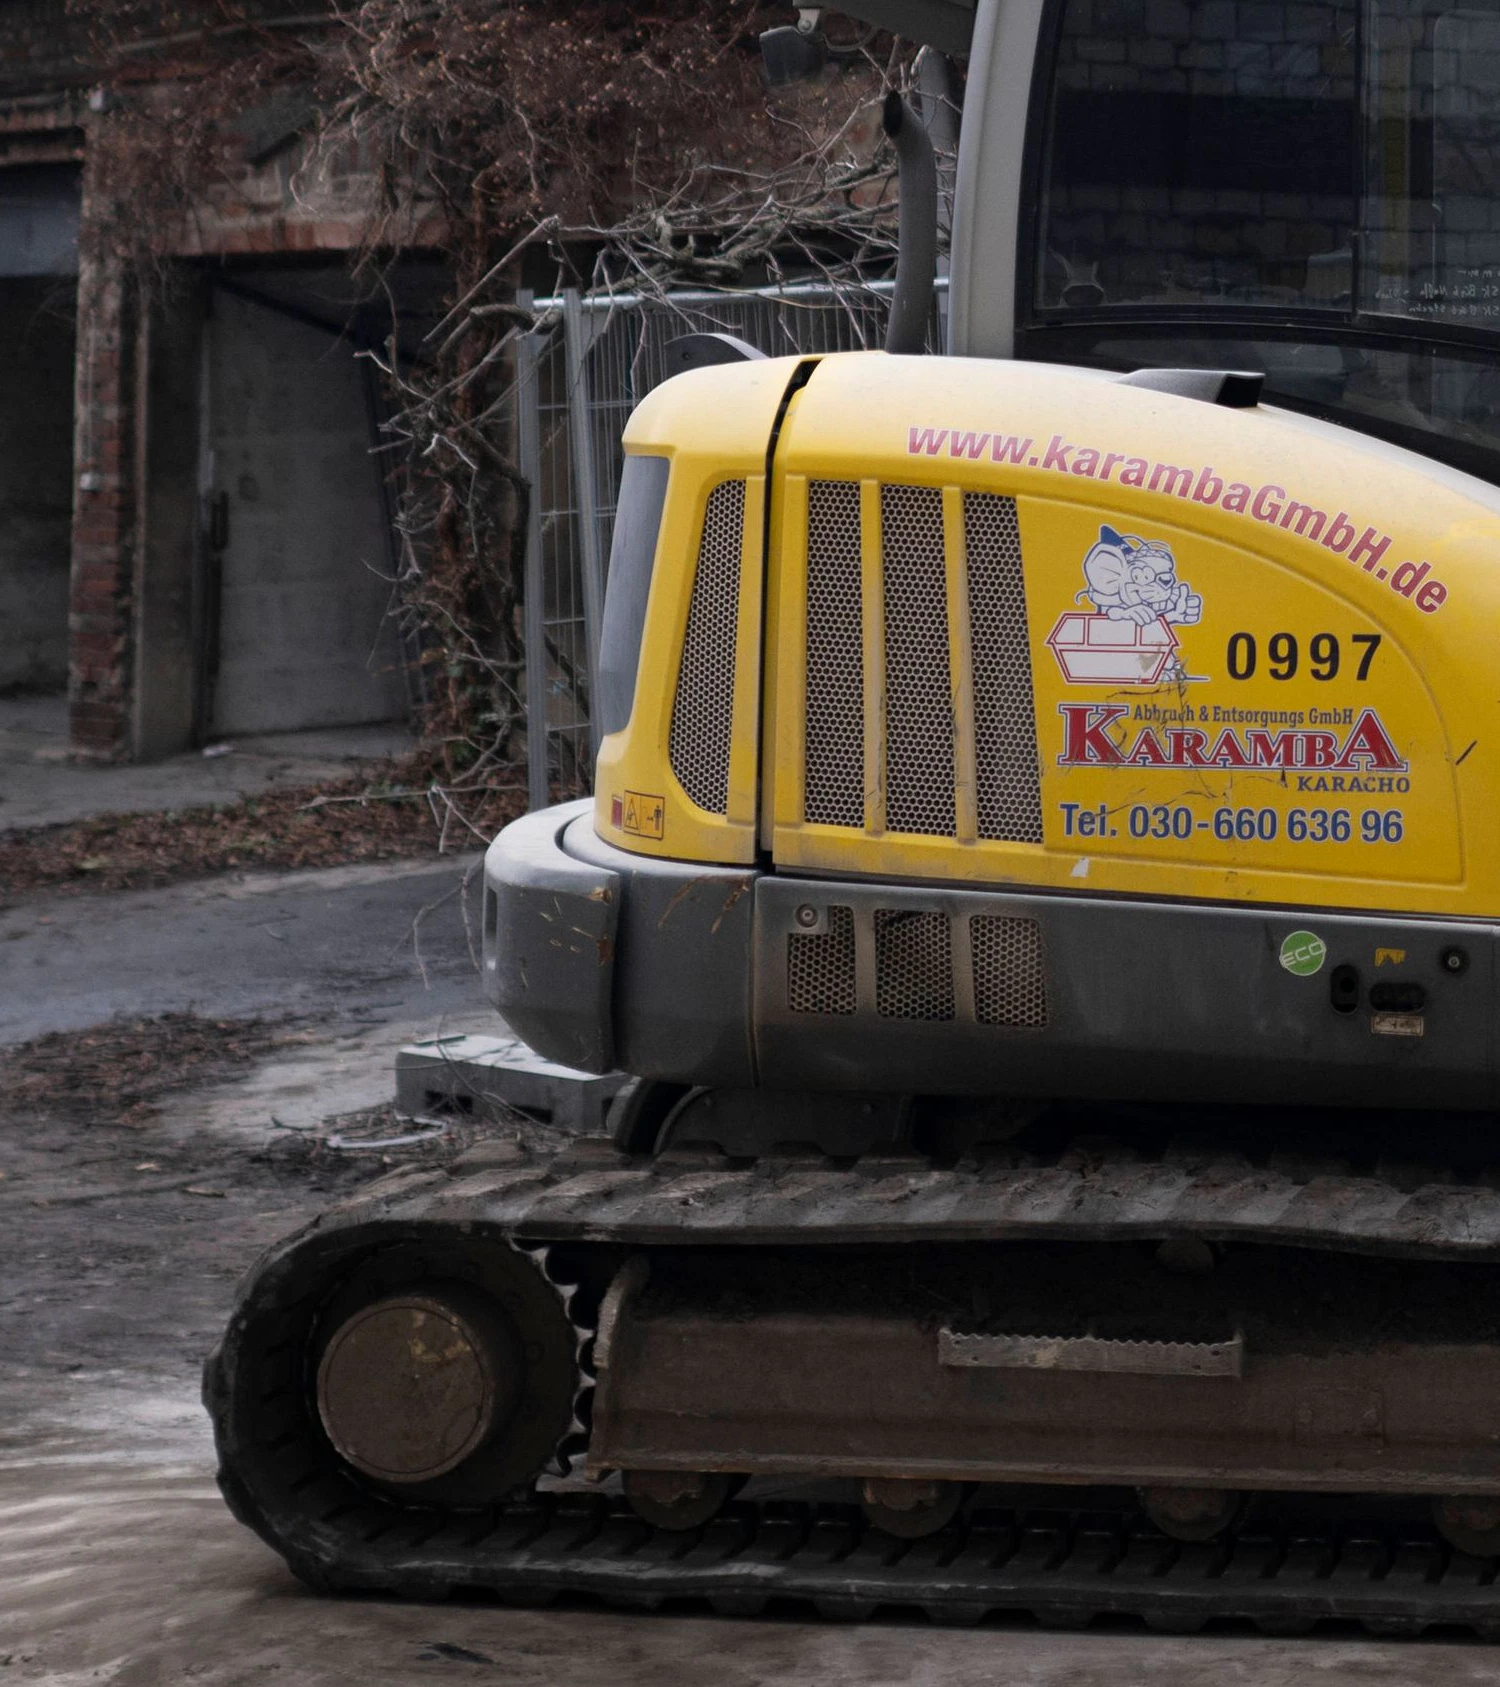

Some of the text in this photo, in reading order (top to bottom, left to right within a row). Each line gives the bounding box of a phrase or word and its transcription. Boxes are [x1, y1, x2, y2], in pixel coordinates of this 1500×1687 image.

[906, 425, 1449, 614] www.karambaGmbH.de
[1226, 632, 1382, 681] 0997
[1133, 705, 1353, 728] Abbruch & Entsorgungs GmbH
[1056, 703, 1409, 773] KARAMBA
[1297, 776, 1411, 793] KARACHO
[1059, 802, 1118, 838] Tel.
[1288, 808, 1351, 843] 636
[1361, 809, 1404, 844] 96
[1280, 939, 1327, 968] ECO
